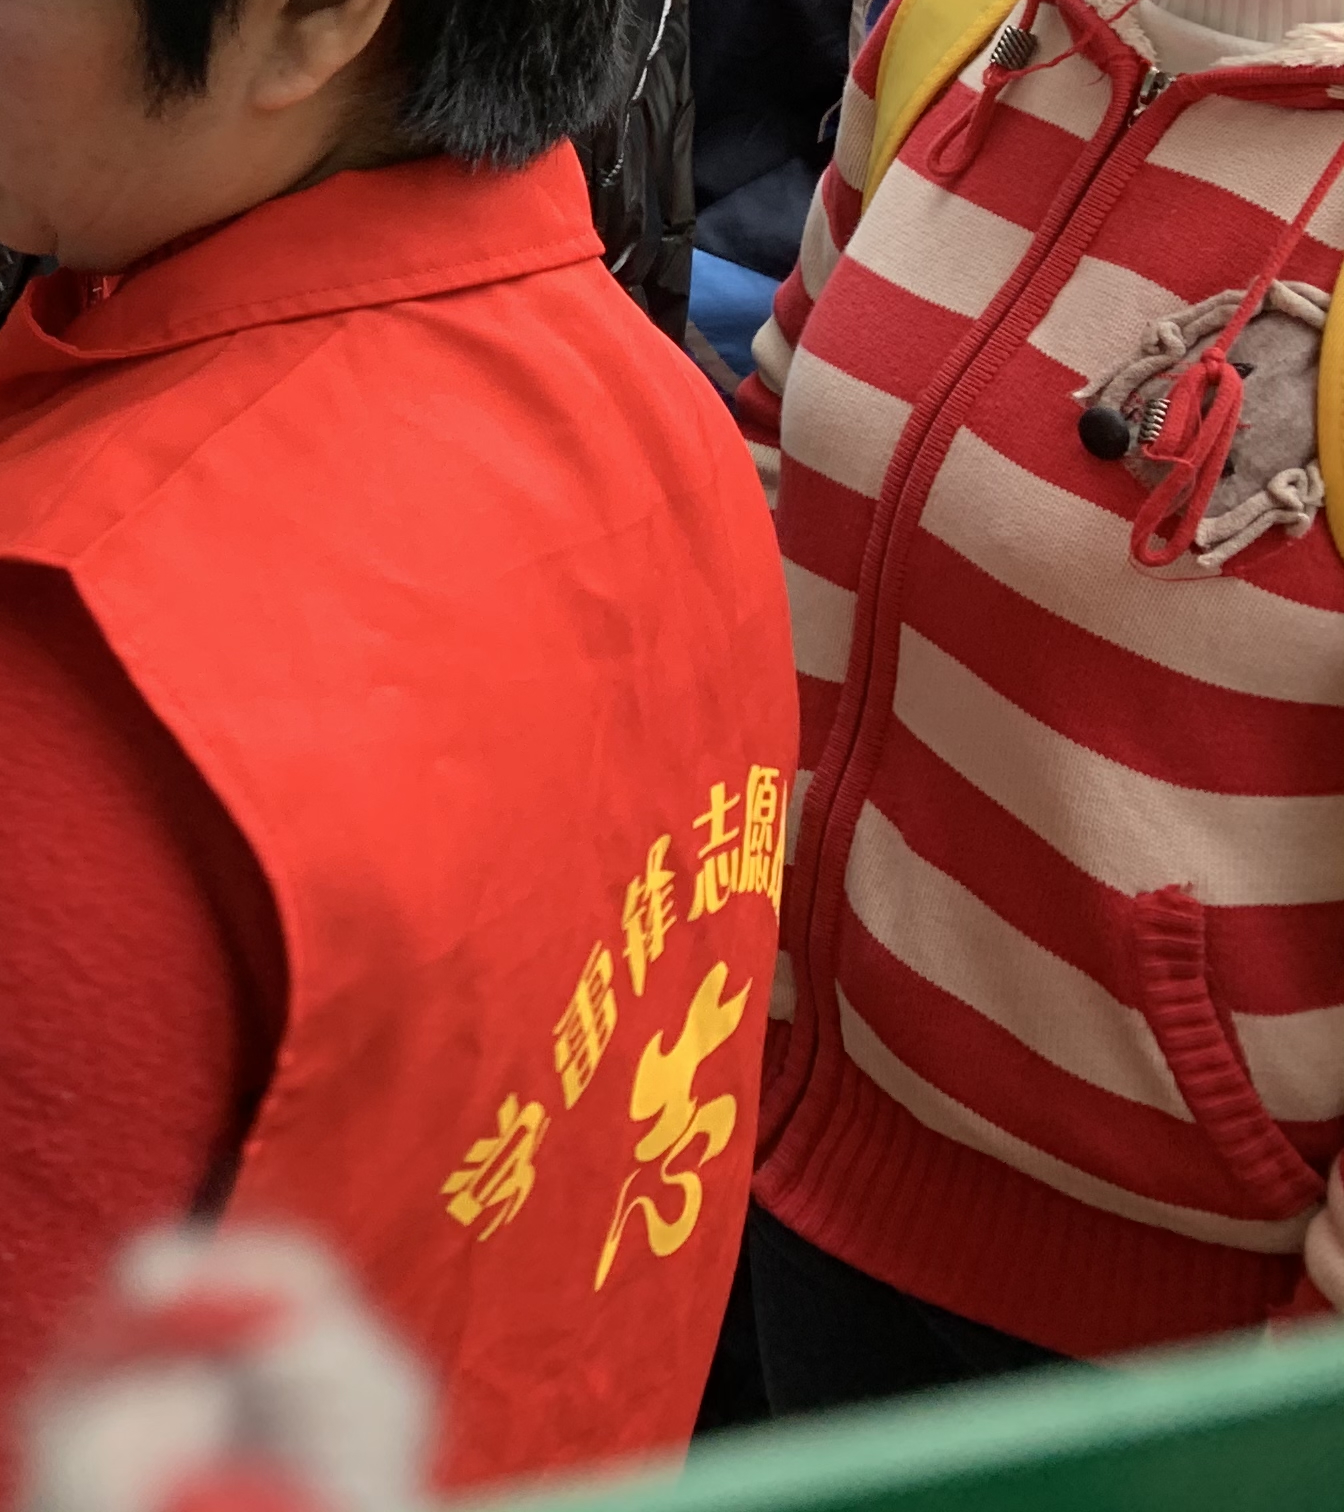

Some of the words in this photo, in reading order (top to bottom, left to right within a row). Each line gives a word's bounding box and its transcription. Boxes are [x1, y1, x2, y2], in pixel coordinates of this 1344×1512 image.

[440, 764, 788, 1244] 学雷锋志愿
